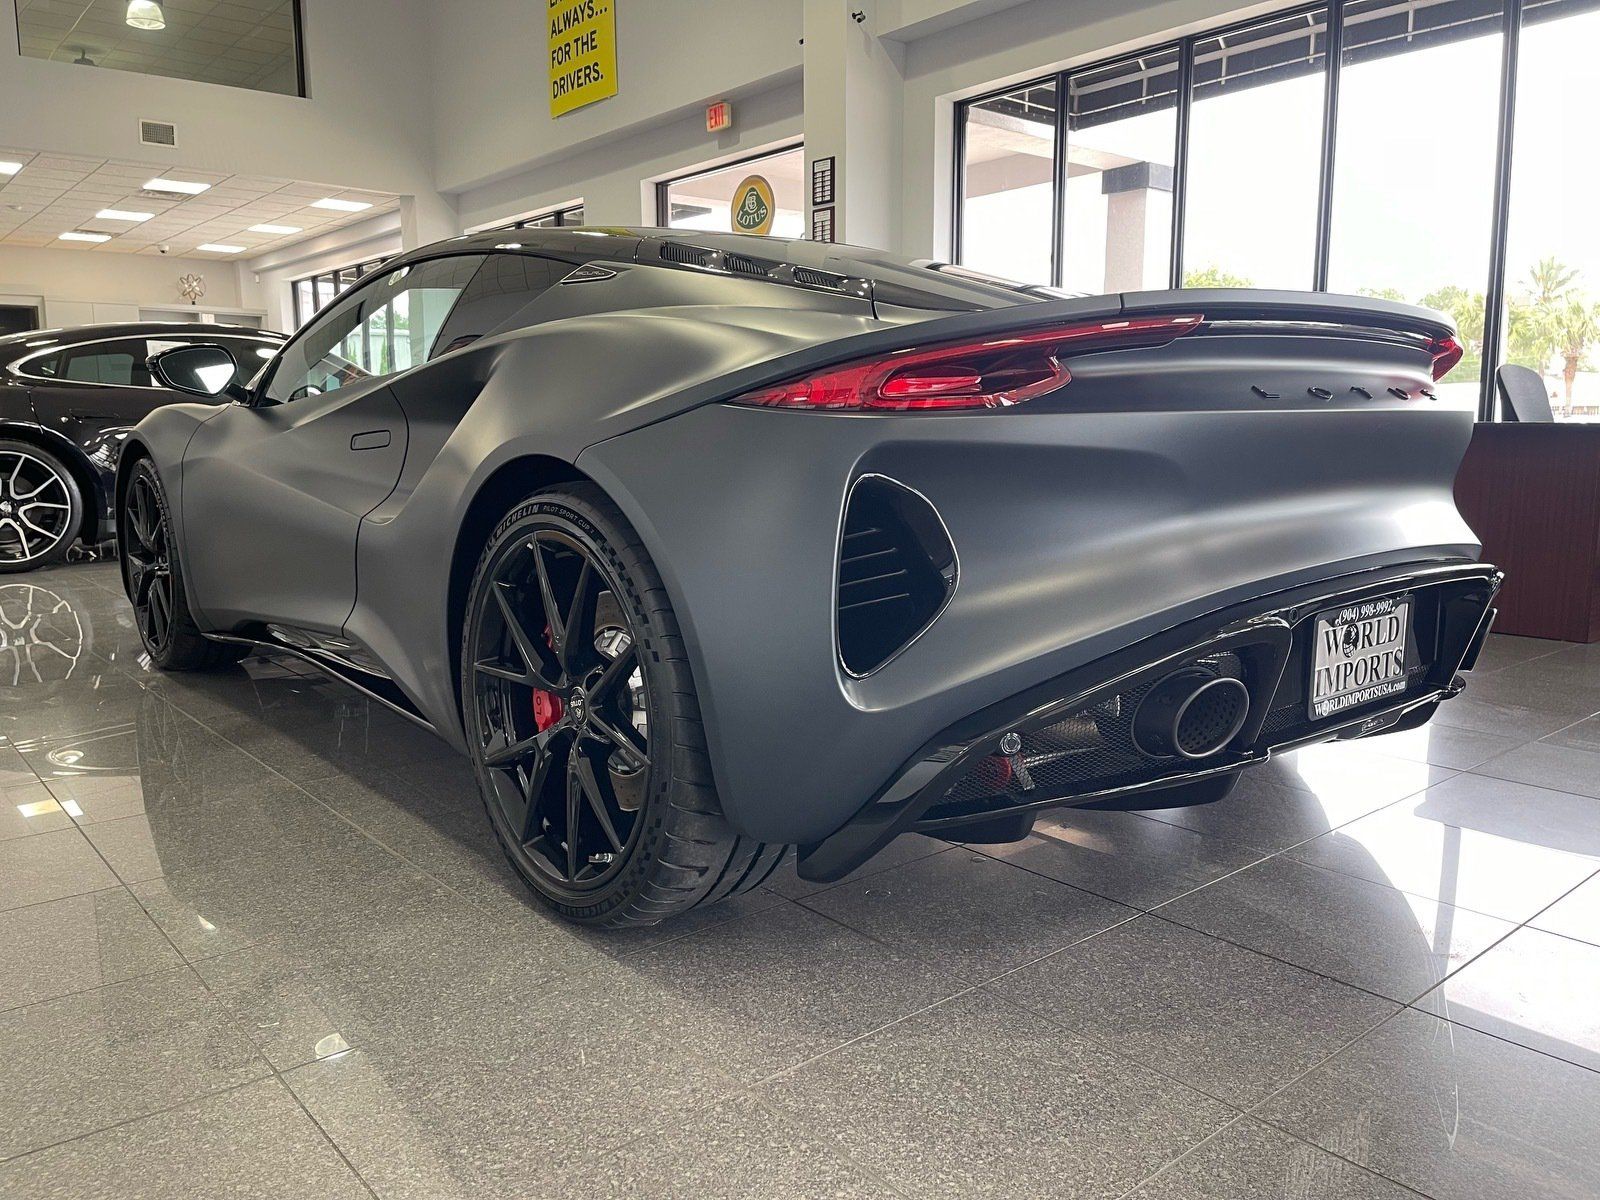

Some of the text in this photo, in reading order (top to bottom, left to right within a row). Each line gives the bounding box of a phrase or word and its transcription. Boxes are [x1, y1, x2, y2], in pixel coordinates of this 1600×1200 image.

[551, 0, 607, 39] ALWAYS...
[552, 30, 598, 69] FOR THE
[552, 62, 604, 99] DRIVERS.
[709, 104, 724, 128] EXIT
[737, 206, 767, 225] LOTUS
[1251, 385, 1437, 401] LOTUS
[496, 504, 540, 538] MICHELIN
[559, 508, 578, 522] SPORT
[578, 519, 590, 530] CUP
[1338, 600, 1393, 625] (904) 998-9992
[1323, 615, 1400, 658] WORLD
[1315, 647, 1403, 698] IMPORTS
